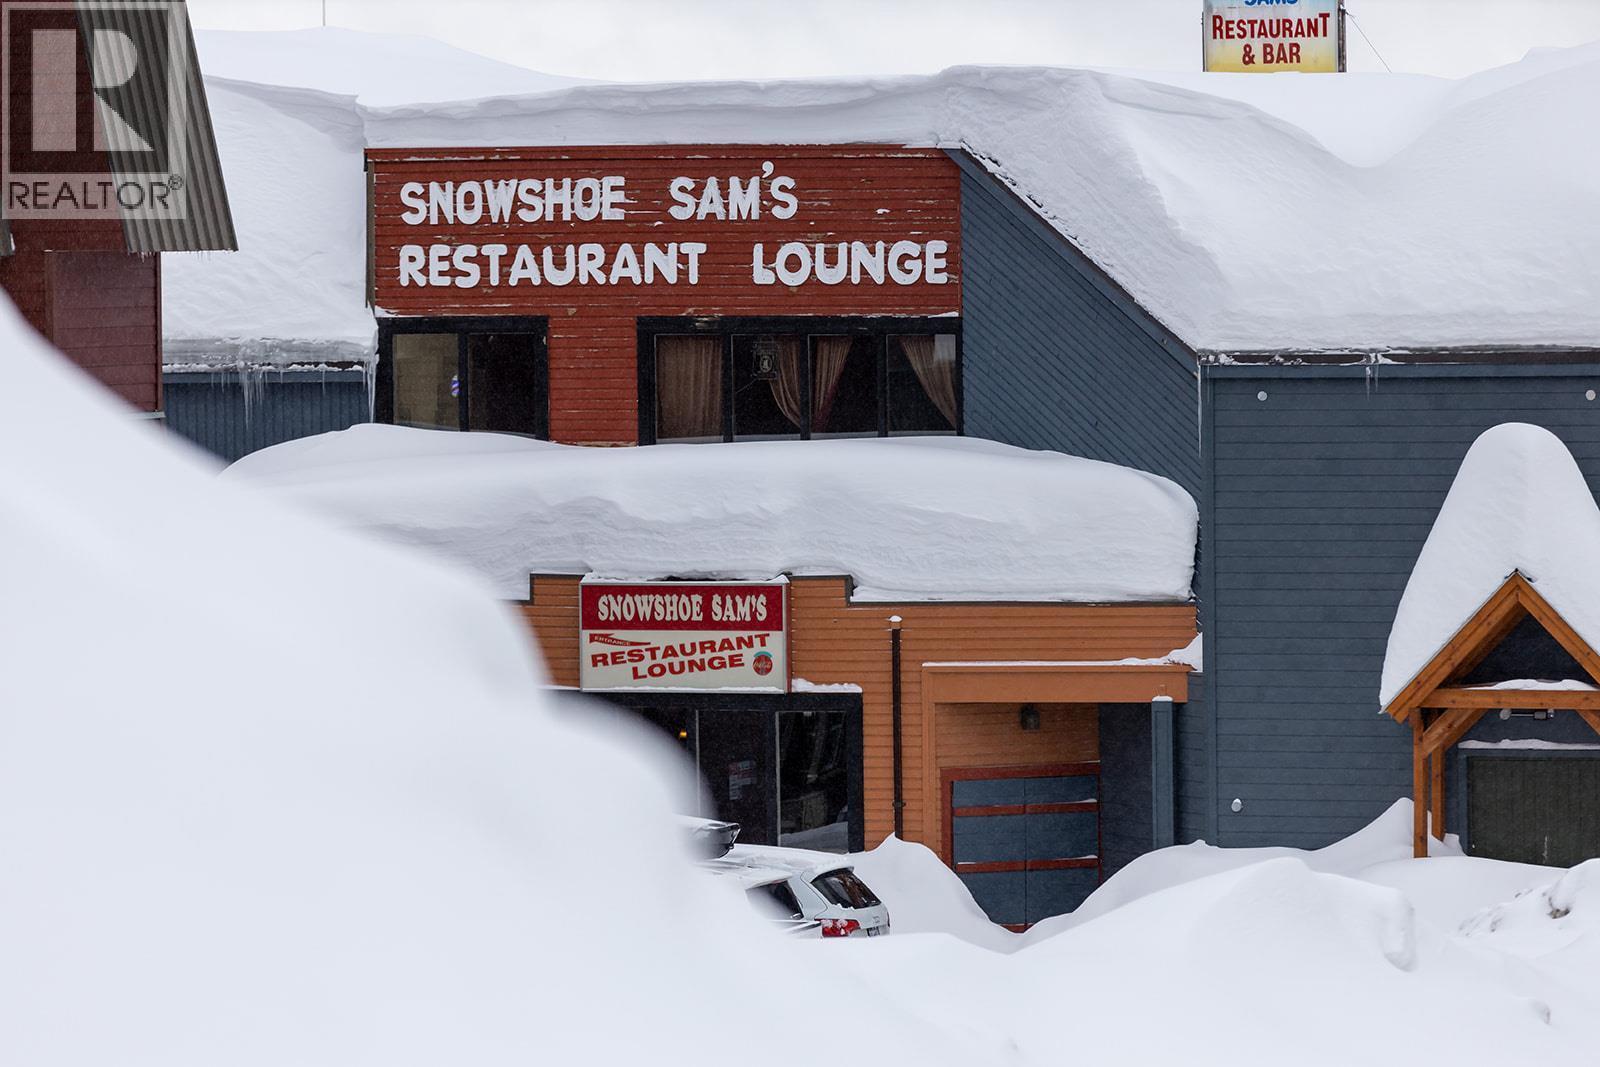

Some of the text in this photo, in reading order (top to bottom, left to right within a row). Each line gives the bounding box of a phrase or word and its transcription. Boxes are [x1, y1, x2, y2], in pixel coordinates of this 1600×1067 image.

[1212, 13, 1330, 39] RESTAURANT
[1242, 43, 1301, 65] & BAR
[400, 160, 798, 225] SNOWSHOE SAM'S
[398, 240, 949, 288] RESTAURANT LOUNGE
[598, 593, 767, 622] SNOWSHOE SAM'S
[591, 633, 770, 667] RESTAURANT
[631, 653, 745, 680] LOUNGE
